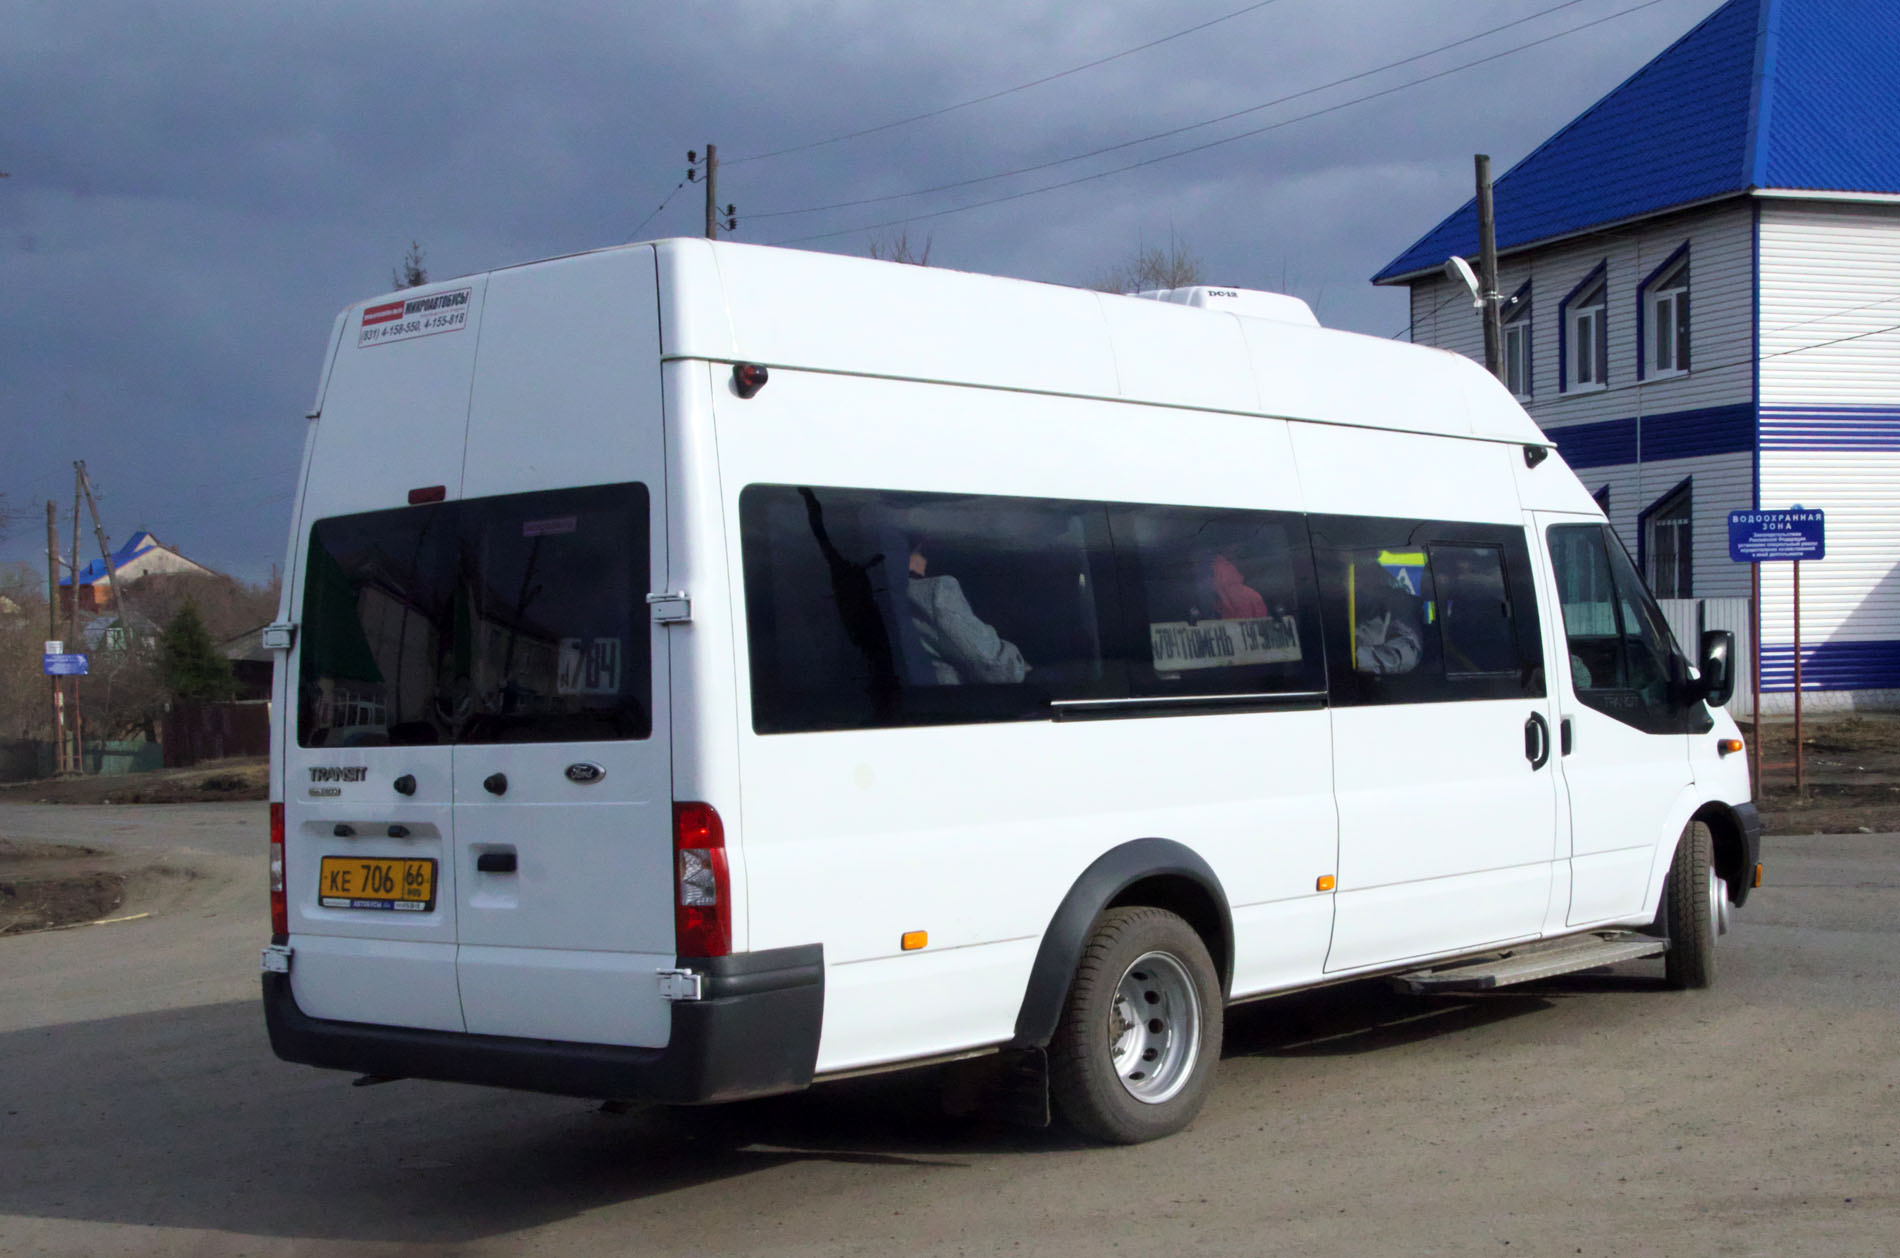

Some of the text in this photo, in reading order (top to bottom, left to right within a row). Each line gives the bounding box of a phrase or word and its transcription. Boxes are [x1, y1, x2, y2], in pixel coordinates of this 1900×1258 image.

[405, 291, 469, 315] МИКРОАВТОБУСЫ
[1732, 513, 1822, 523] ВОДООХРАННАЯ
[309, 767, 367, 782] TRANSIT
[361, 865, 394, 893] 706
[406, 864, 424, 886] 66
